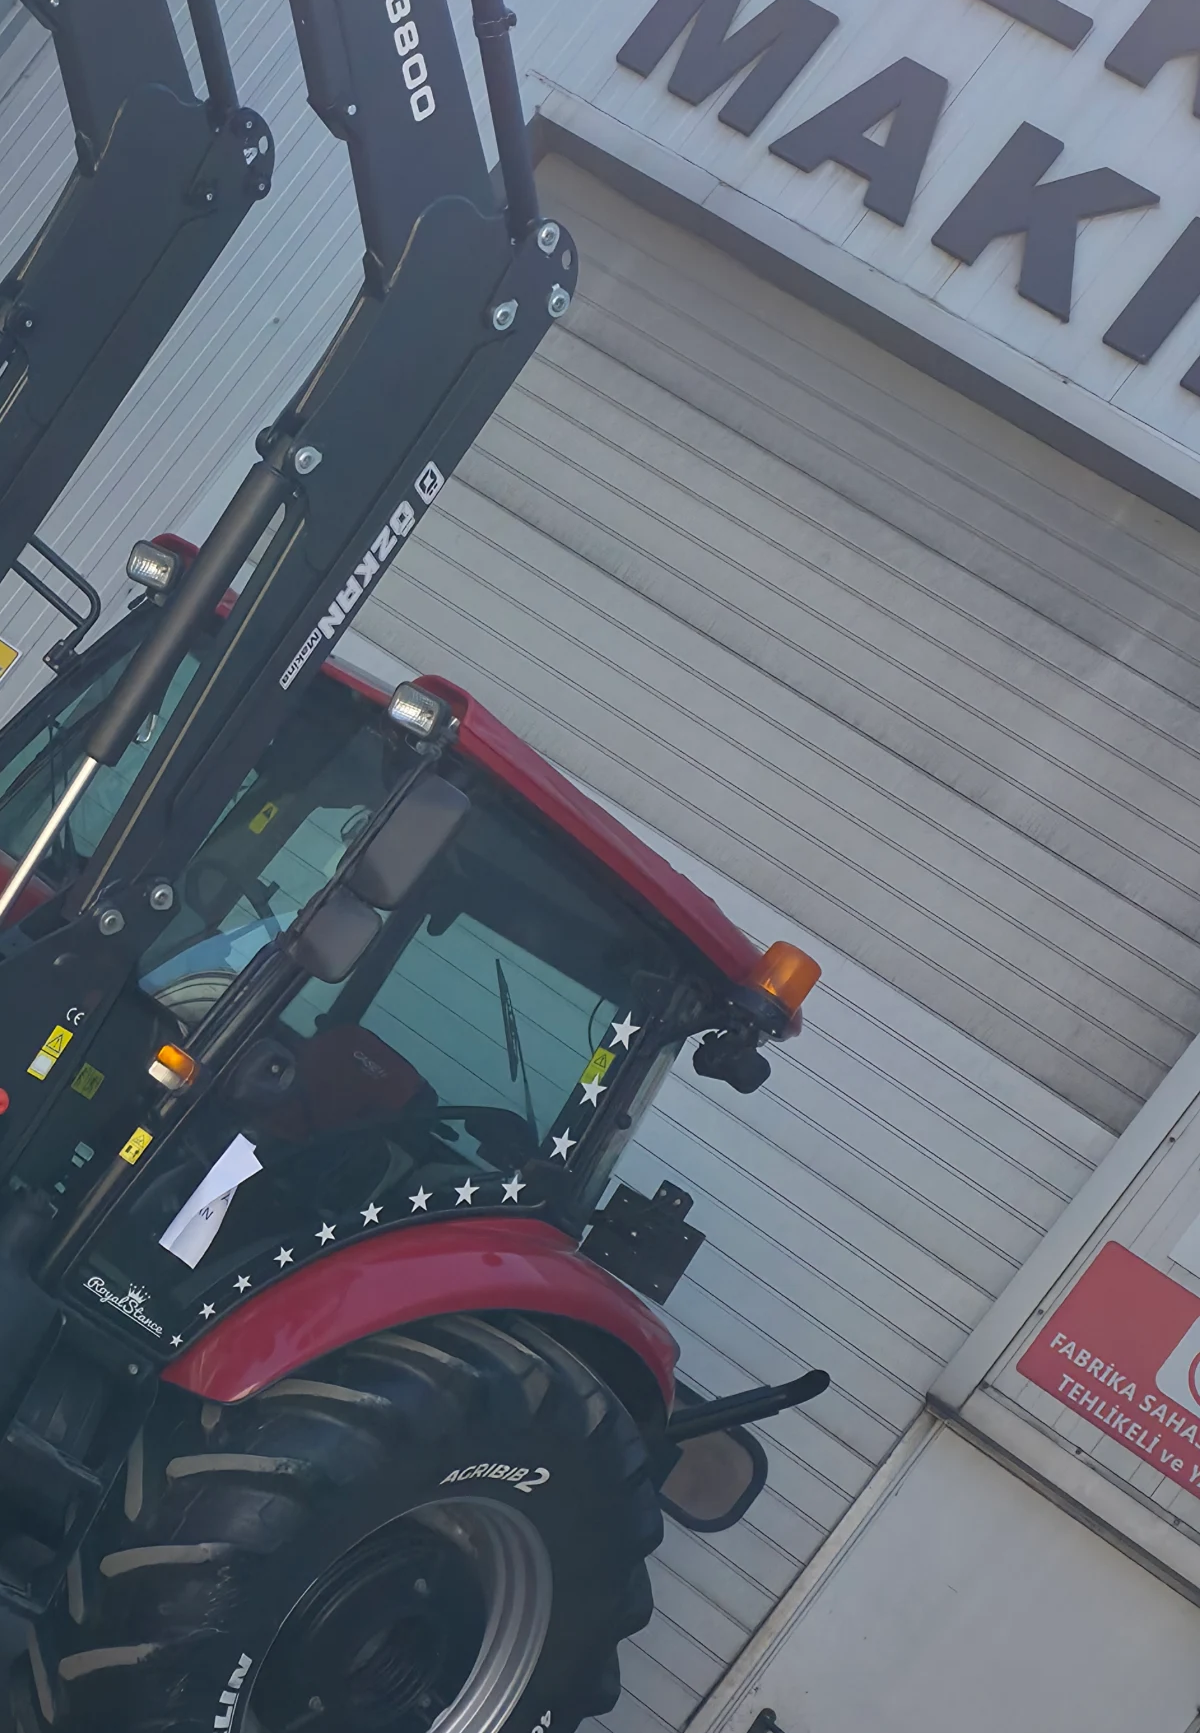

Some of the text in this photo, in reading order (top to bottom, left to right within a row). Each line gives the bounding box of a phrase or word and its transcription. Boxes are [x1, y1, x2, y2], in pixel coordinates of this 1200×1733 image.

[318, 500, 416, 640] ÖZKAN
[280, 629, 321, 686] Makina
[1050, 1332, 1200, 1449] FABRİKA SAHA
[1058, 1373, 1162, 1454] TEHLİKELİ
[1160, 1448, 1184, 1472] ve
